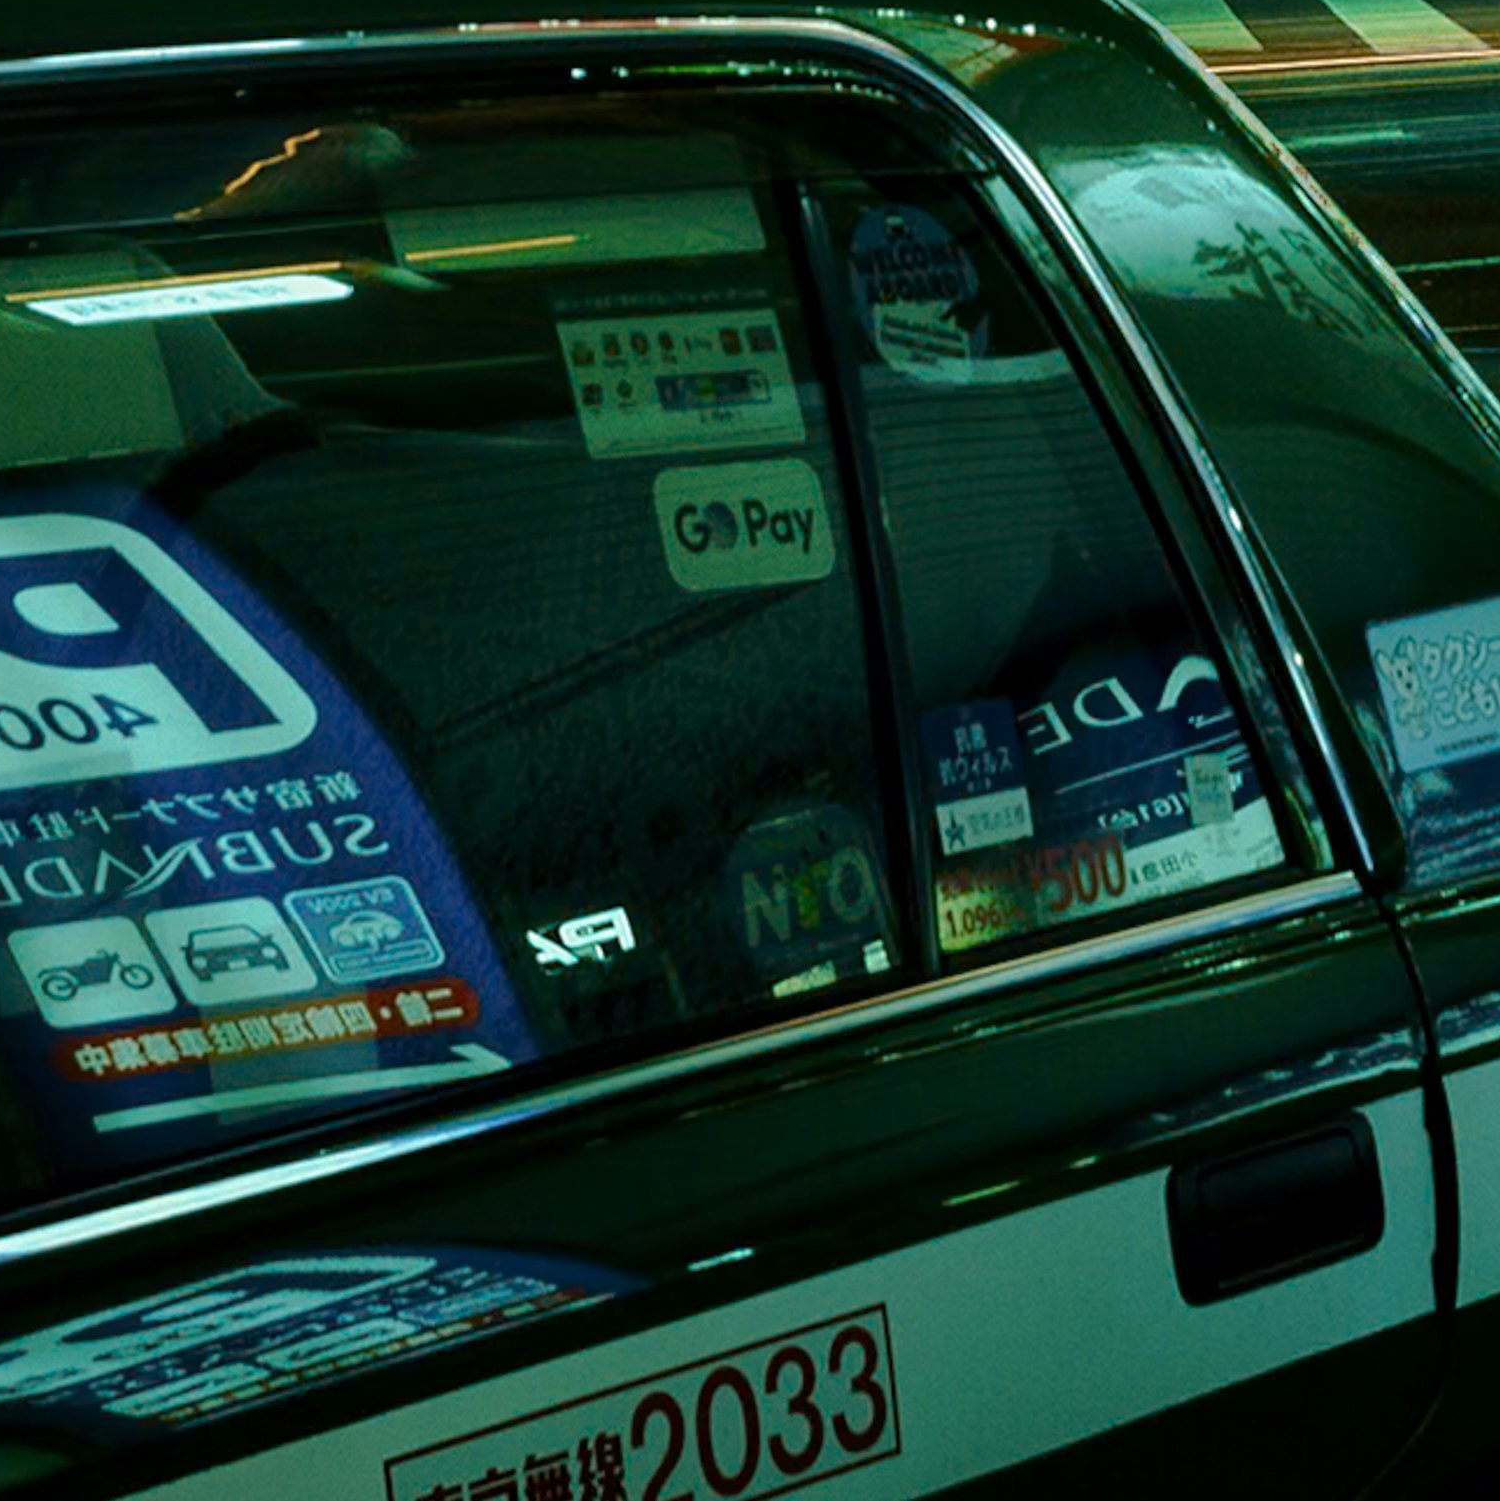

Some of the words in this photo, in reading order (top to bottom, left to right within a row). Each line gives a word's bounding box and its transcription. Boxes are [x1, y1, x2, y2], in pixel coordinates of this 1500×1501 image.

[743, 500, 814, 553] Pay
[420, 1426, 628, 1501] 無線
[634, 1324, 887, 1501] 2033
